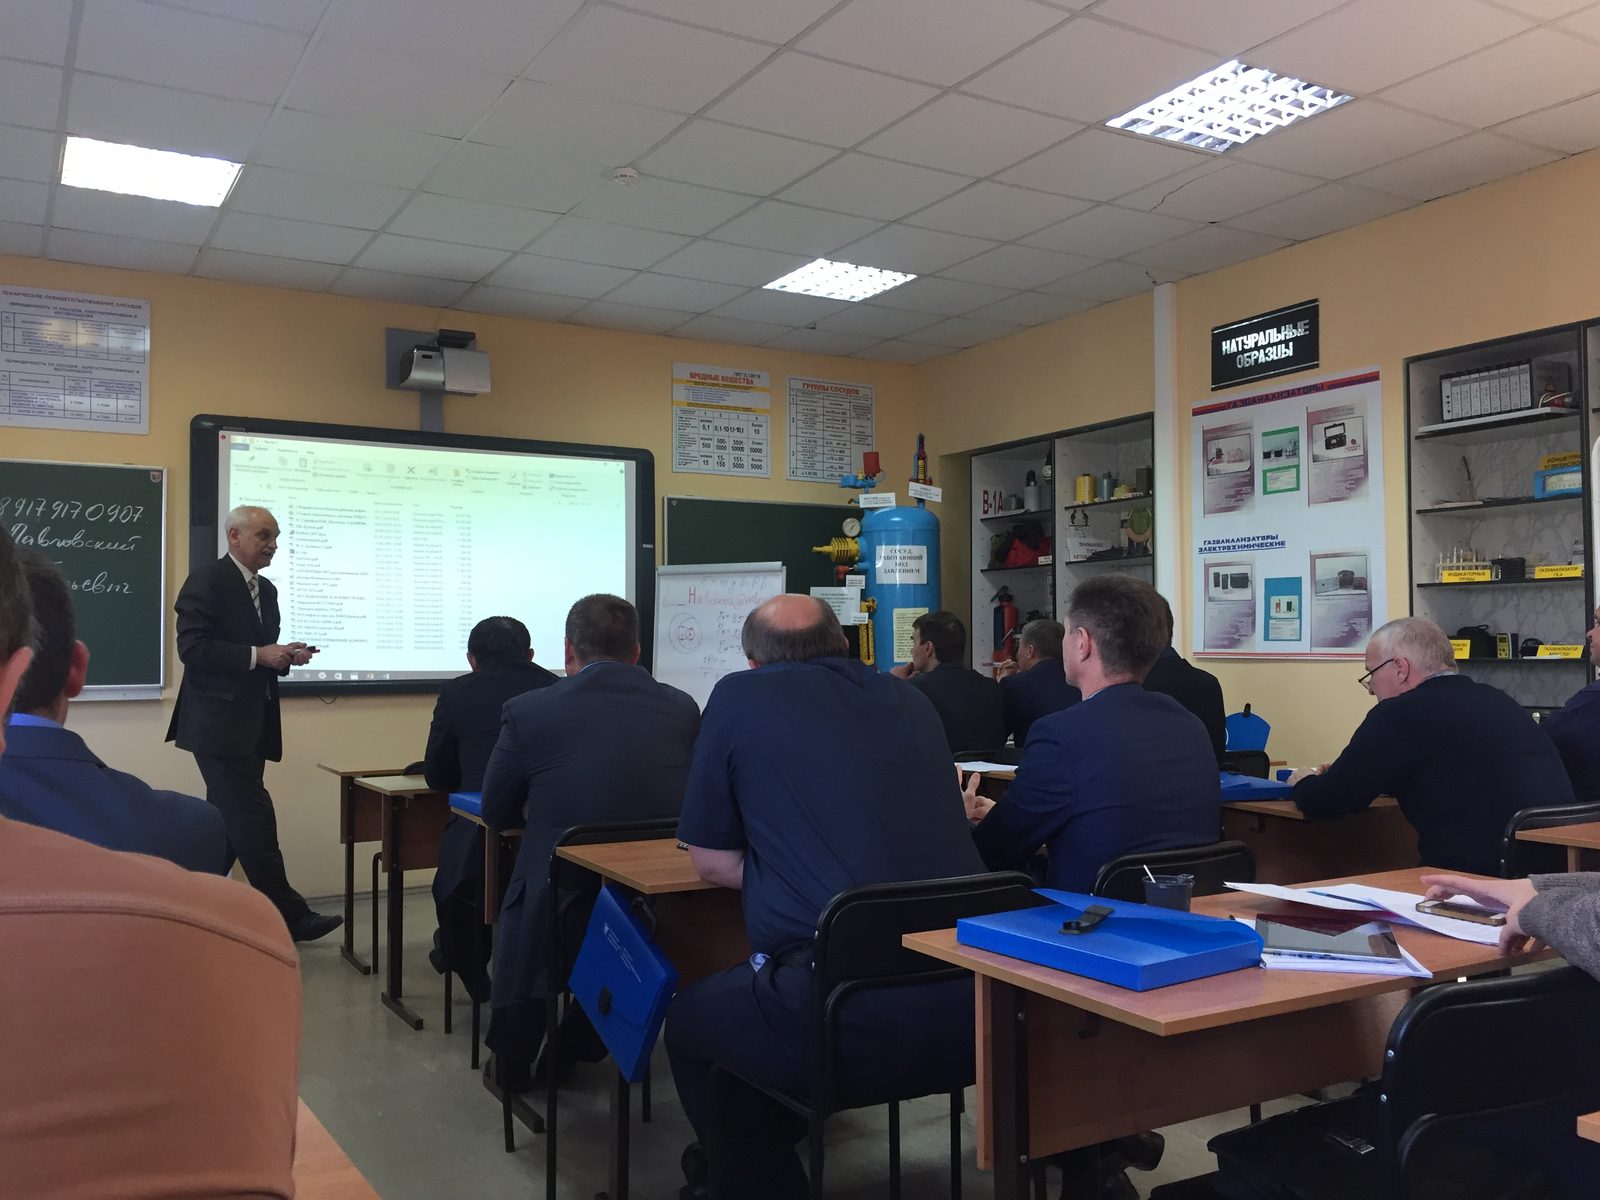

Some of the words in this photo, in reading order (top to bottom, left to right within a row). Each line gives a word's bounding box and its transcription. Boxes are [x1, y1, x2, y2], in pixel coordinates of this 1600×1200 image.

[1221, 319, 1310, 356] НАТУРАЛЬНЫЕ
[1236, 341, 1294, 369] ОБРАЗЦЫ
[689, 371, 720, 382] ВРЕДНЫЕ
[721, 375, 754, 385] ВЕЩЕСТВА
[802, 382, 829, 392] ГРУППЫ
[830, 386, 860, 396] СОСУДОВ
[1227, 383, 1324, 409] ГАЗОАНАЛИЗАТОРЫ
[732, 462, 745, 470] 5000
[1198, 540, 1286, 553] ЭЛЕКТРОХИМИЧЕСКИЕ
[1203, 534, 1279, 546] ГАЗОАНАЛИЗАТОРЫ
